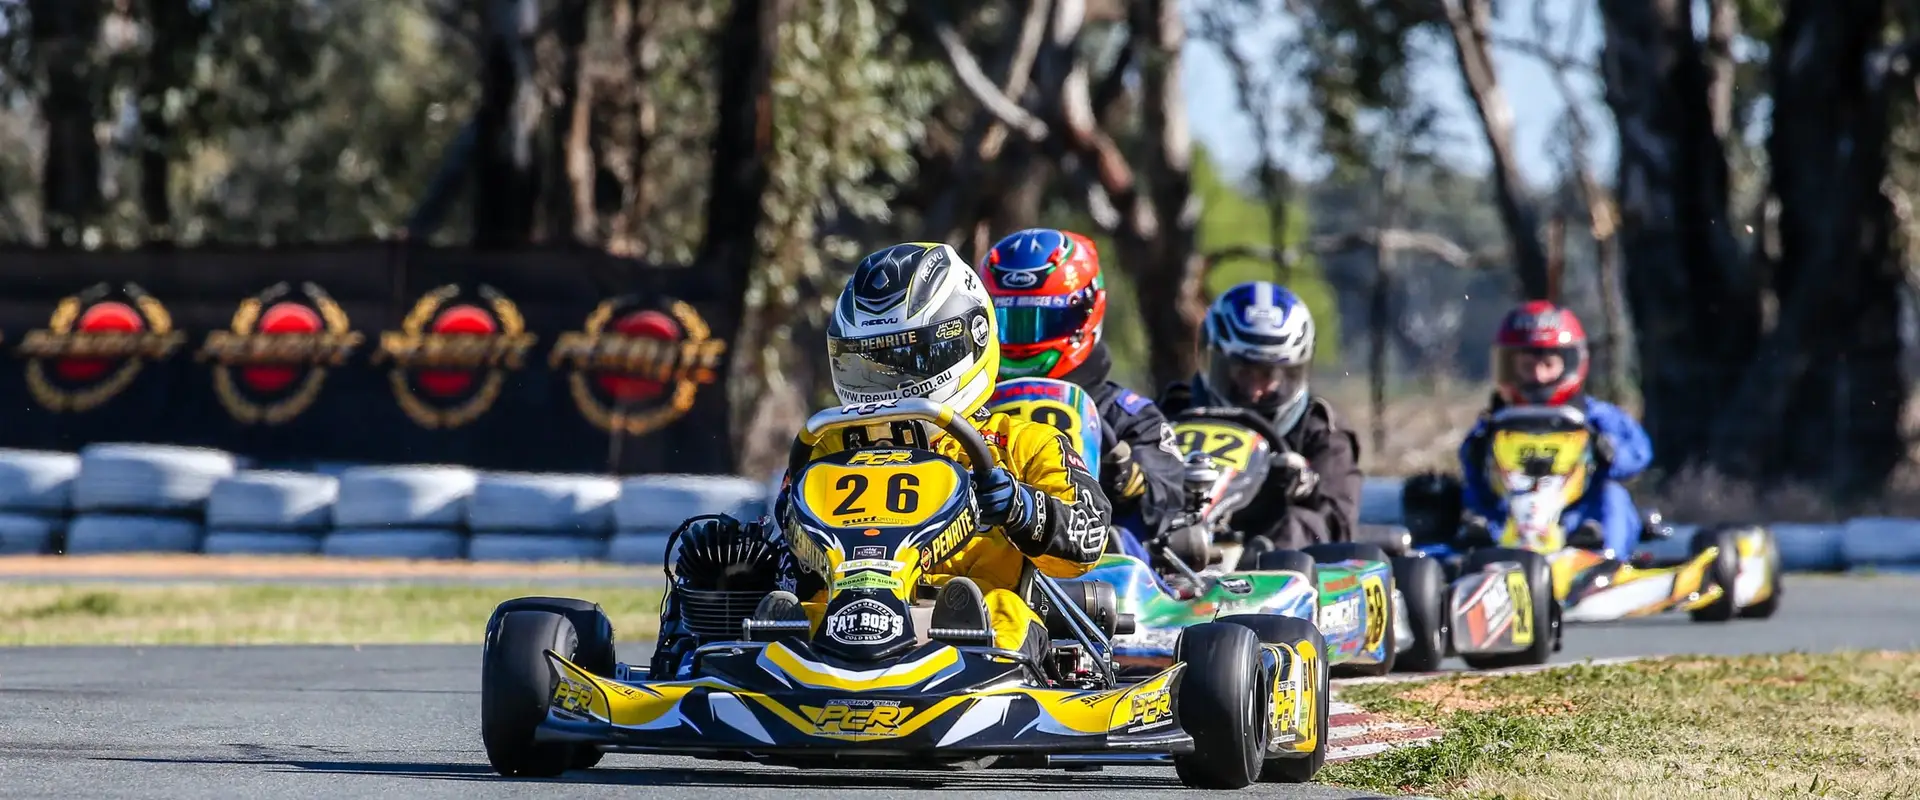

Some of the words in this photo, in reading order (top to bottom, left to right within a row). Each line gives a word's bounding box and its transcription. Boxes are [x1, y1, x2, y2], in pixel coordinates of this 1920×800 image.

[920, 251, 944, 282] REEVU
[861, 317, 898, 327] REEVU
[860, 331, 917, 352] PENRITE
[838, 371, 953, 403] www.reevu.com.au
[847, 452, 913, 466] PCR
[931, 508, 975, 564] PENRITE
[877, 578, 898, 586] SIGNS
[827, 614, 858, 635] FAT
[860, 612, 904, 636] BOB'S
[553, 681, 593, 712] PCR
[1127, 691, 1173, 725] PCR
[814, 705, 901, 731] PCR
